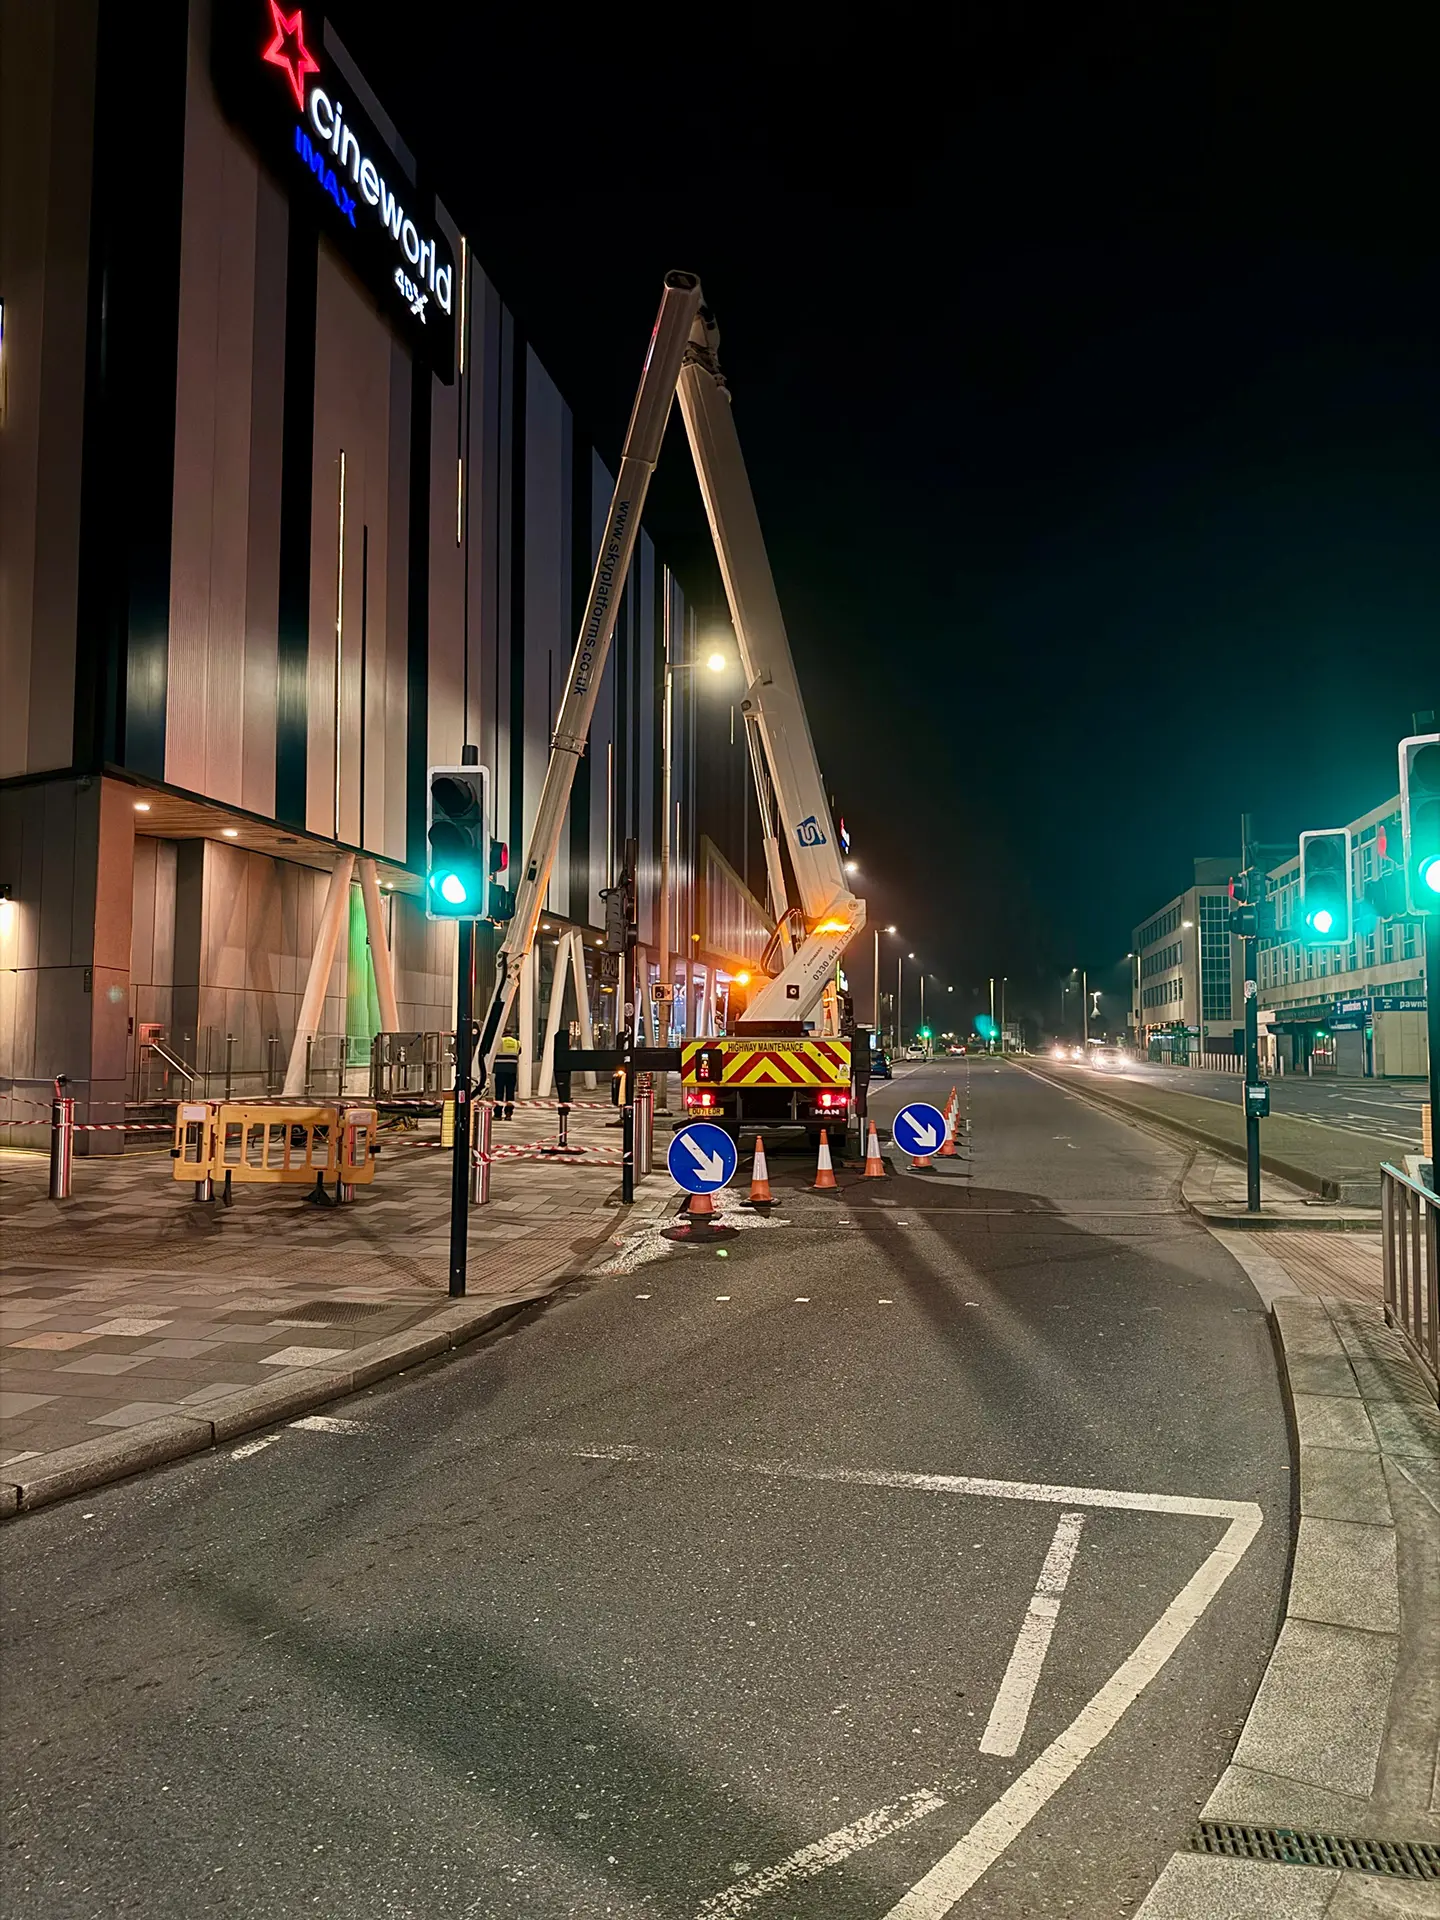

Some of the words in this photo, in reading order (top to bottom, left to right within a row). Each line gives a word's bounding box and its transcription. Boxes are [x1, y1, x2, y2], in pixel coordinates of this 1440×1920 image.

[296, 125, 357, 228] IMAX
[310, 88, 452, 315] cineworld
[573, 501, 631, 697] www.skyplatforms.co.uk
[812, 960, 830, 981] 0330
[828, 945, 841, 960] 441
[727, 1042, 757, 1052] HIGHWAY
[758, 1042, 804, 1052] MAINTENANCE
